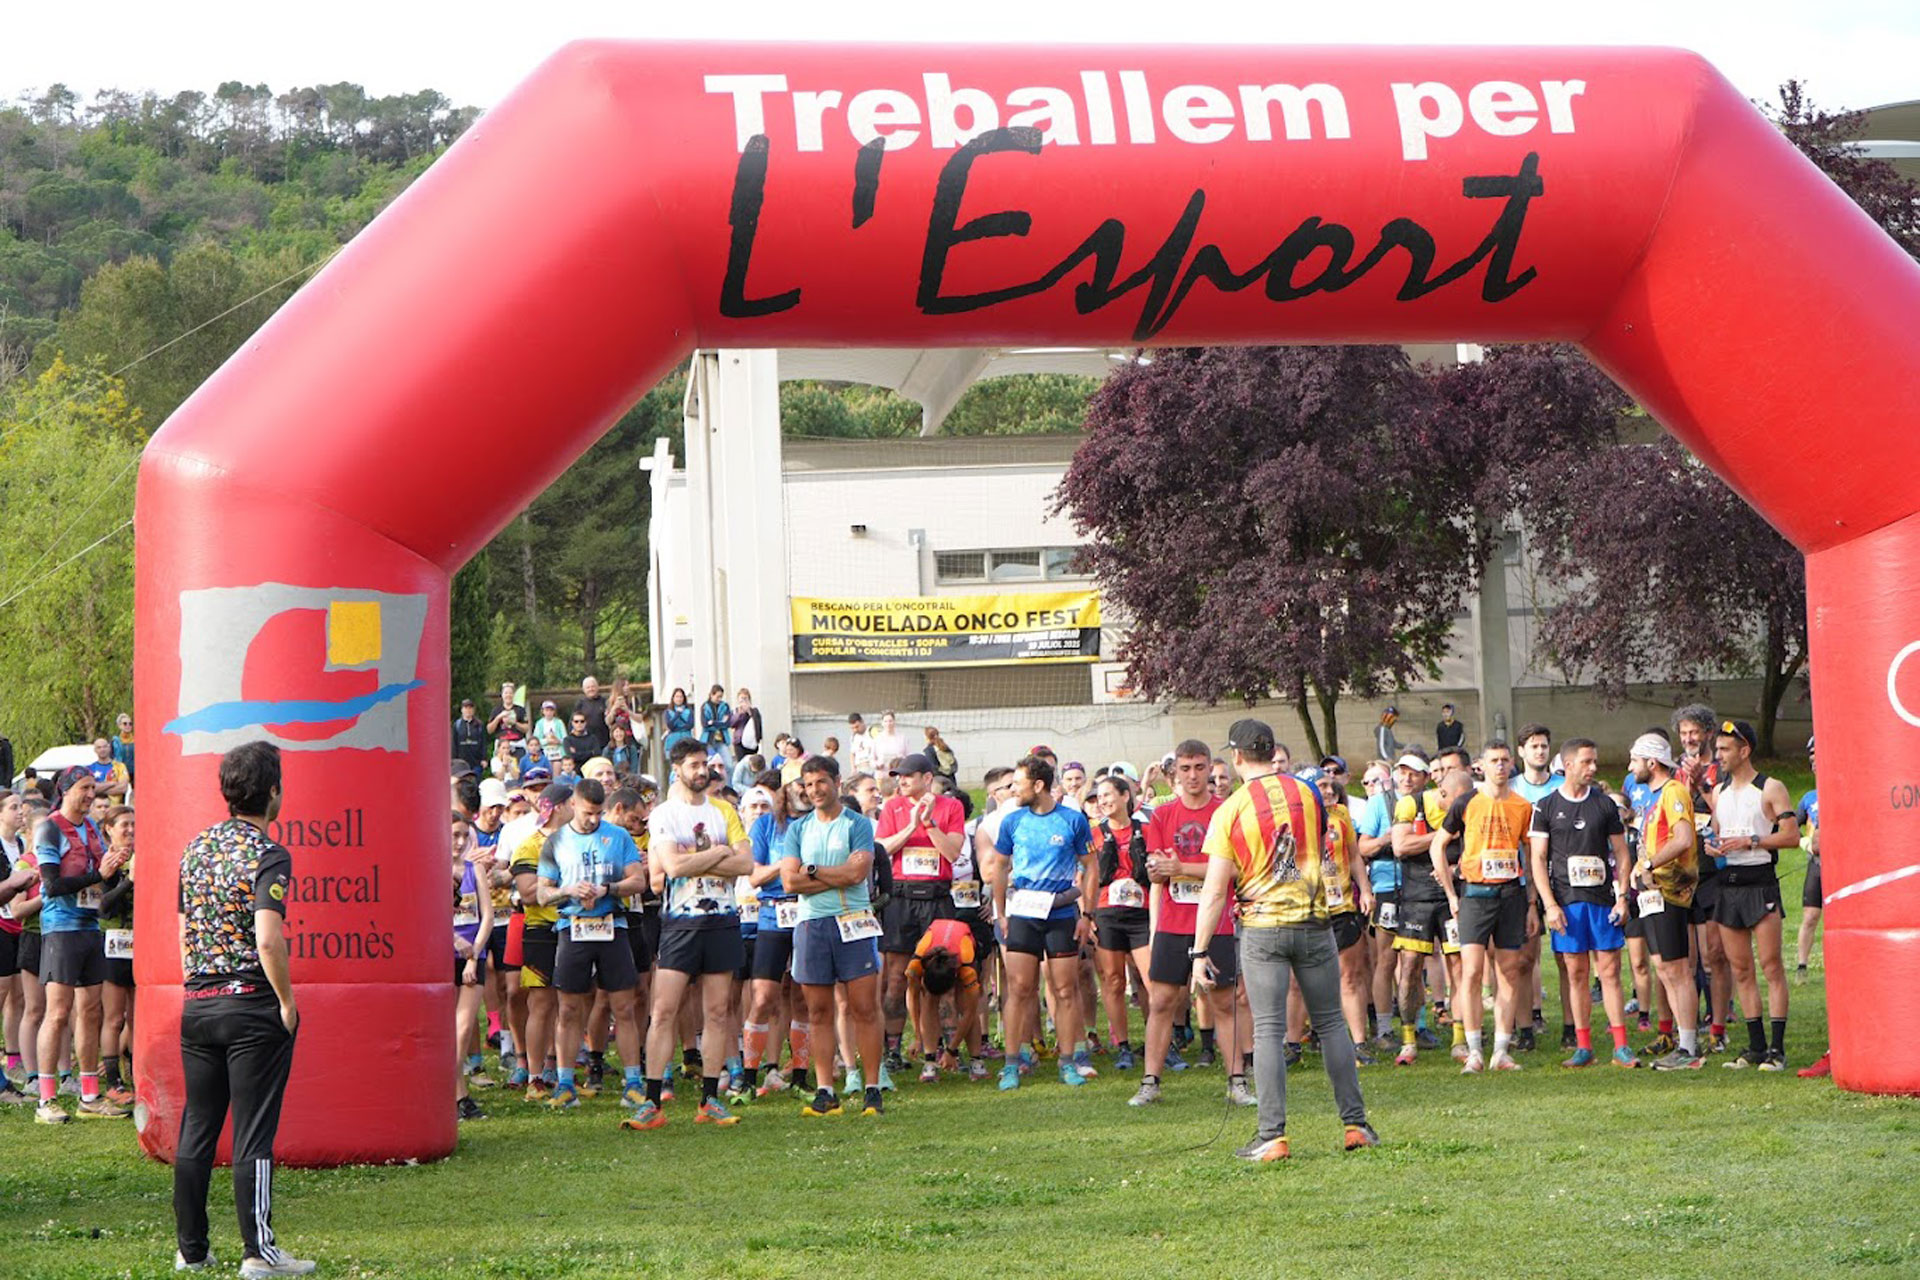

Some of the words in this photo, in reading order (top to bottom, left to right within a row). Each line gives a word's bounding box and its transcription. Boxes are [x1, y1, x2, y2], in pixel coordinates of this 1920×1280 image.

[703, 70, 1351, 153] Treballem
[1390, 79, 1587, 161] per
[720, 126, 1544, 342] L'Esport
[863, 602, 883, 611] PER
[885, 602, 956, 611] L'ONCOTRAIL
[811, 614, 948, 632] MIQUELADA
[954, 612, 1019, 631] ONCO
[1026, 608, 1081, 627] FEST
[811, 638, 844, 647] CURSA
[846, 639, 909, 648] D'OBSTACLES
[916, 638, 948, 647] SOPAR
[812, 647, 857, 656] POPULAR
[863, 647, 914, 656] CONCERTS
[920, 647, 932, 656] DJ
[266, 809, 365, 847] onsell
